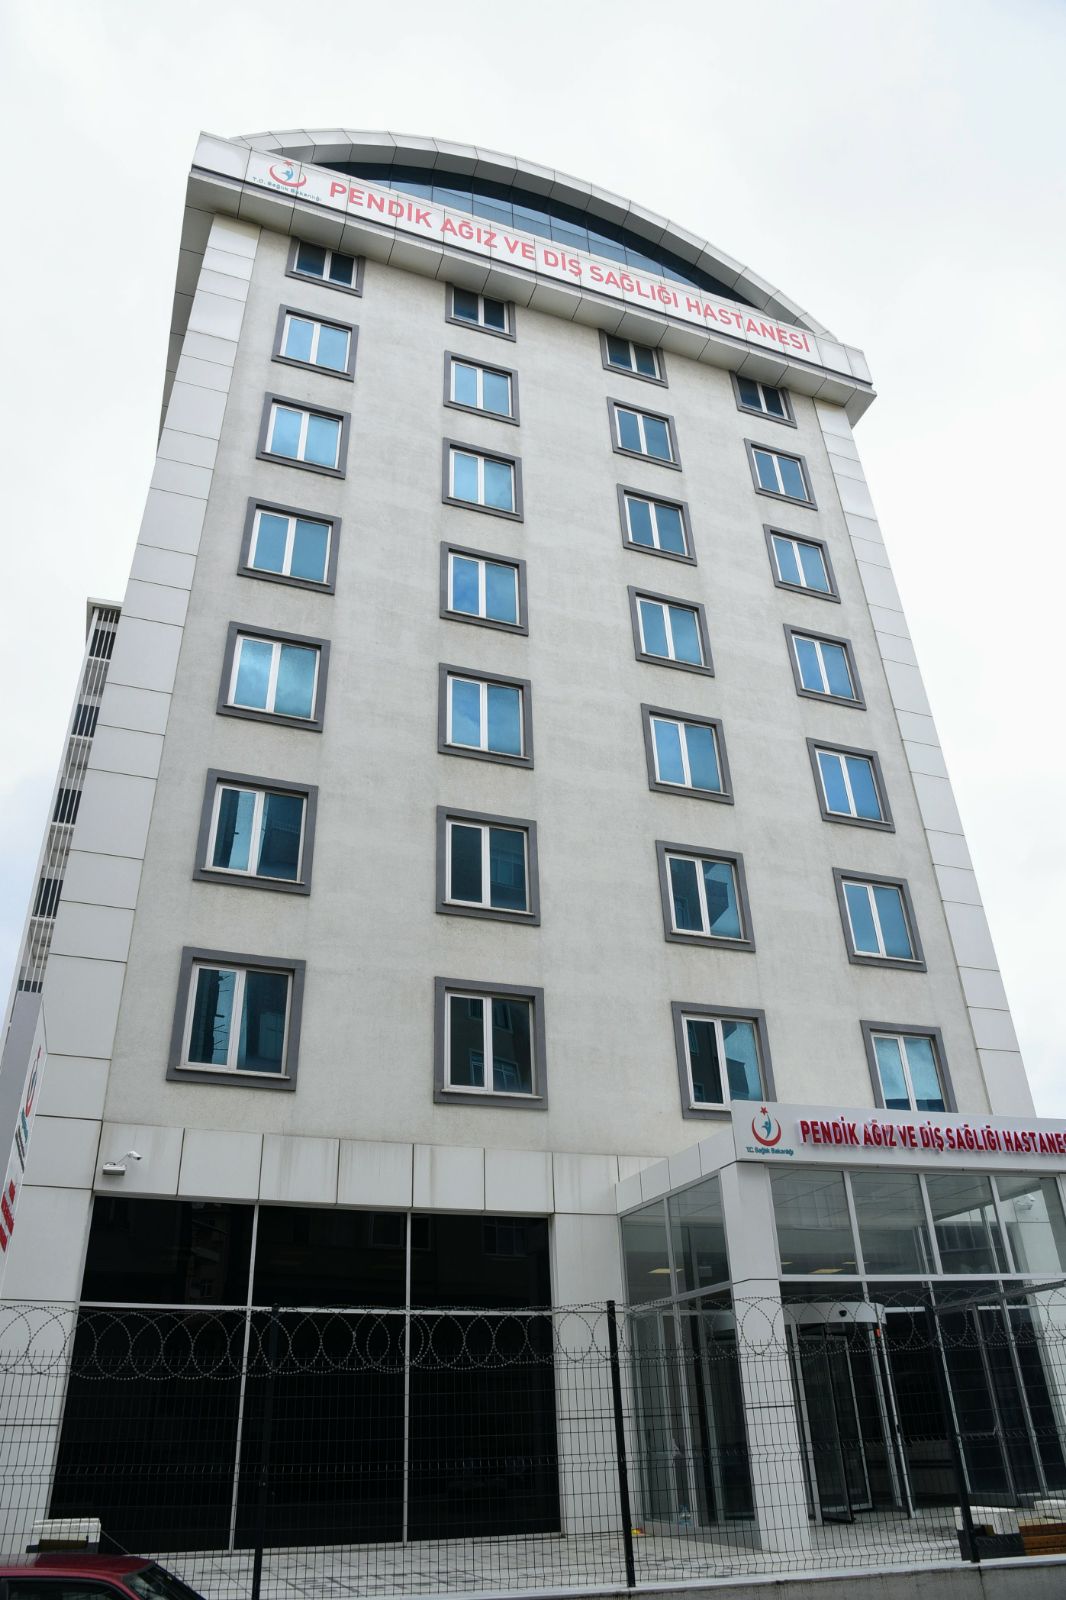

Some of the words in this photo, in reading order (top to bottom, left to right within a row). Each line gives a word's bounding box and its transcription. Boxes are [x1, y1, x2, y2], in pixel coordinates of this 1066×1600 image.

[330, 181, 432, 229] PENDİK
[440, 217, 497, 248] AĞIZ
[503, 236, 535, 262] VE
[544, 249, 583, 278] DİŞ
[589, 264, 679, 309] SAĞLIĞI
[685, 296, 810, 352] HASTANESİ
[800, 1116, 859, 1145] PENDİK
[863, 1119, 897, 1147] AĞIZ
[898, 1125, 919, 1148] VE
[919, 1120, 945, 1152] DİŞ
[946, 1123, 1003, 1151] SAĞLIĞI
